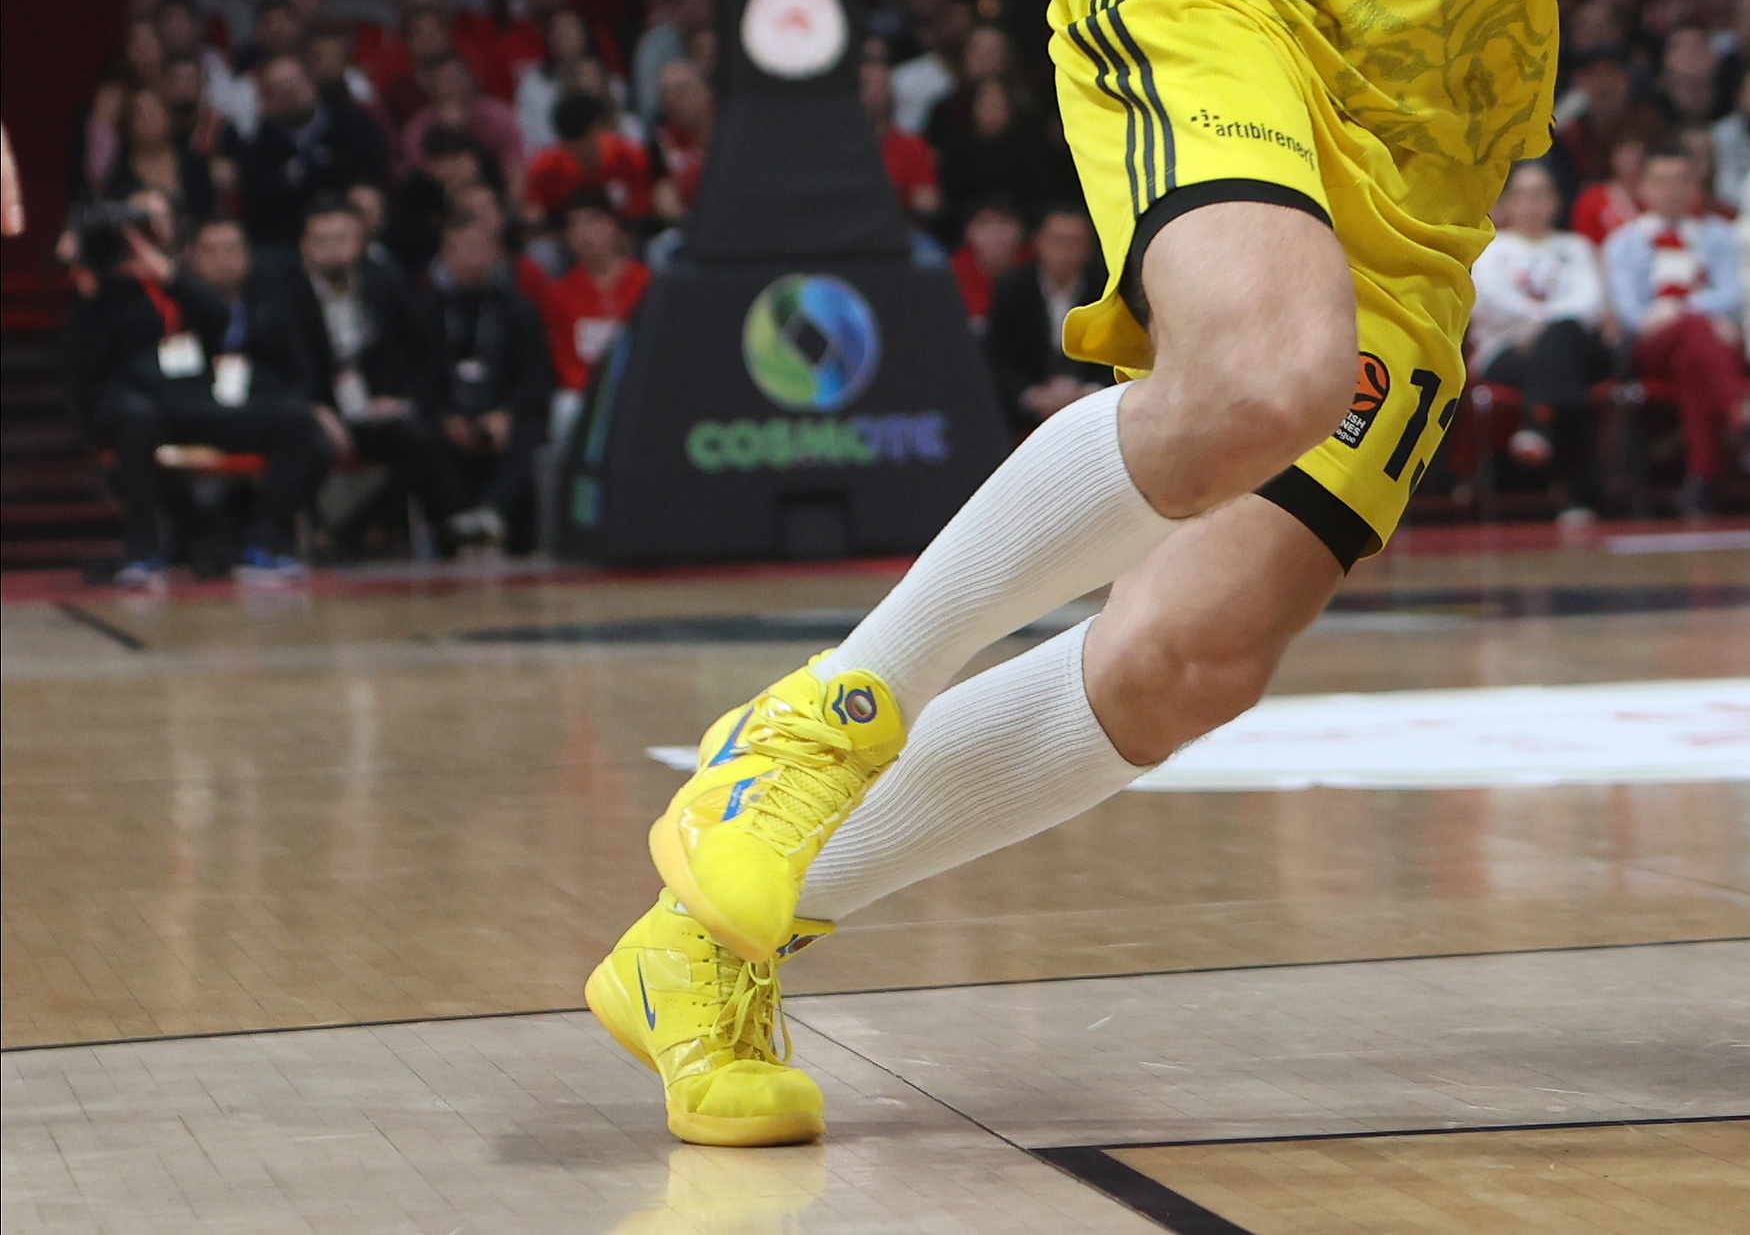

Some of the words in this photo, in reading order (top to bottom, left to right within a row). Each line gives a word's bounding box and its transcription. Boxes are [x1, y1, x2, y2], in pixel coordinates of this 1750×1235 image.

[1340, 419, 1361, 437] NES
[1347, 410, 1366, 429] ISH
[1336, 429, 1356, 444] ague
